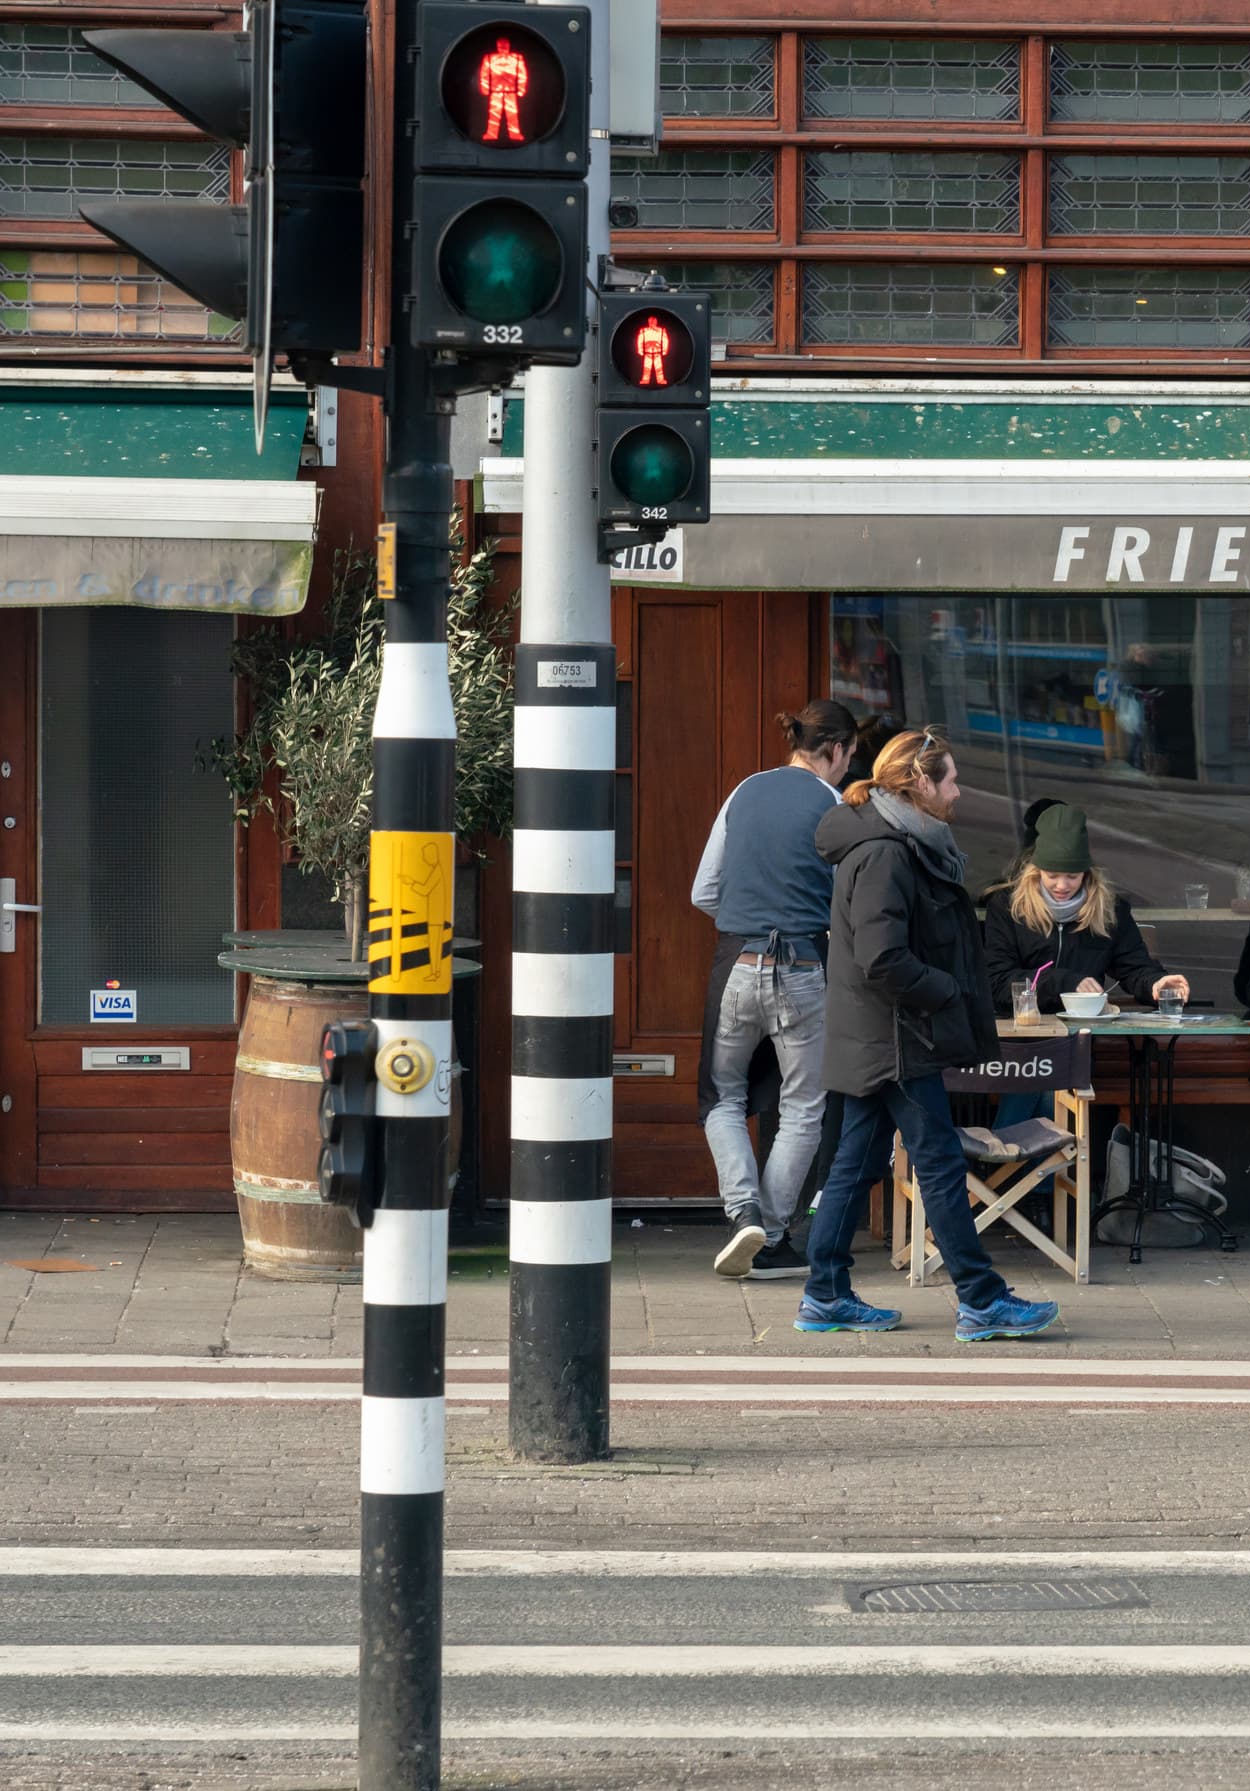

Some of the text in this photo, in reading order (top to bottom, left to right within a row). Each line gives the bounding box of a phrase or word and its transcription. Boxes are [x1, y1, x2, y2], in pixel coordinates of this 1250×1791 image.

[483, 325, 523, 343] 332
[641, 507, 667, 519] 342
[0, 573, 300, 608] en & drinken
[98, 996, 131, 1009] VISA
[961, 1056, 1053, 1078] iends
